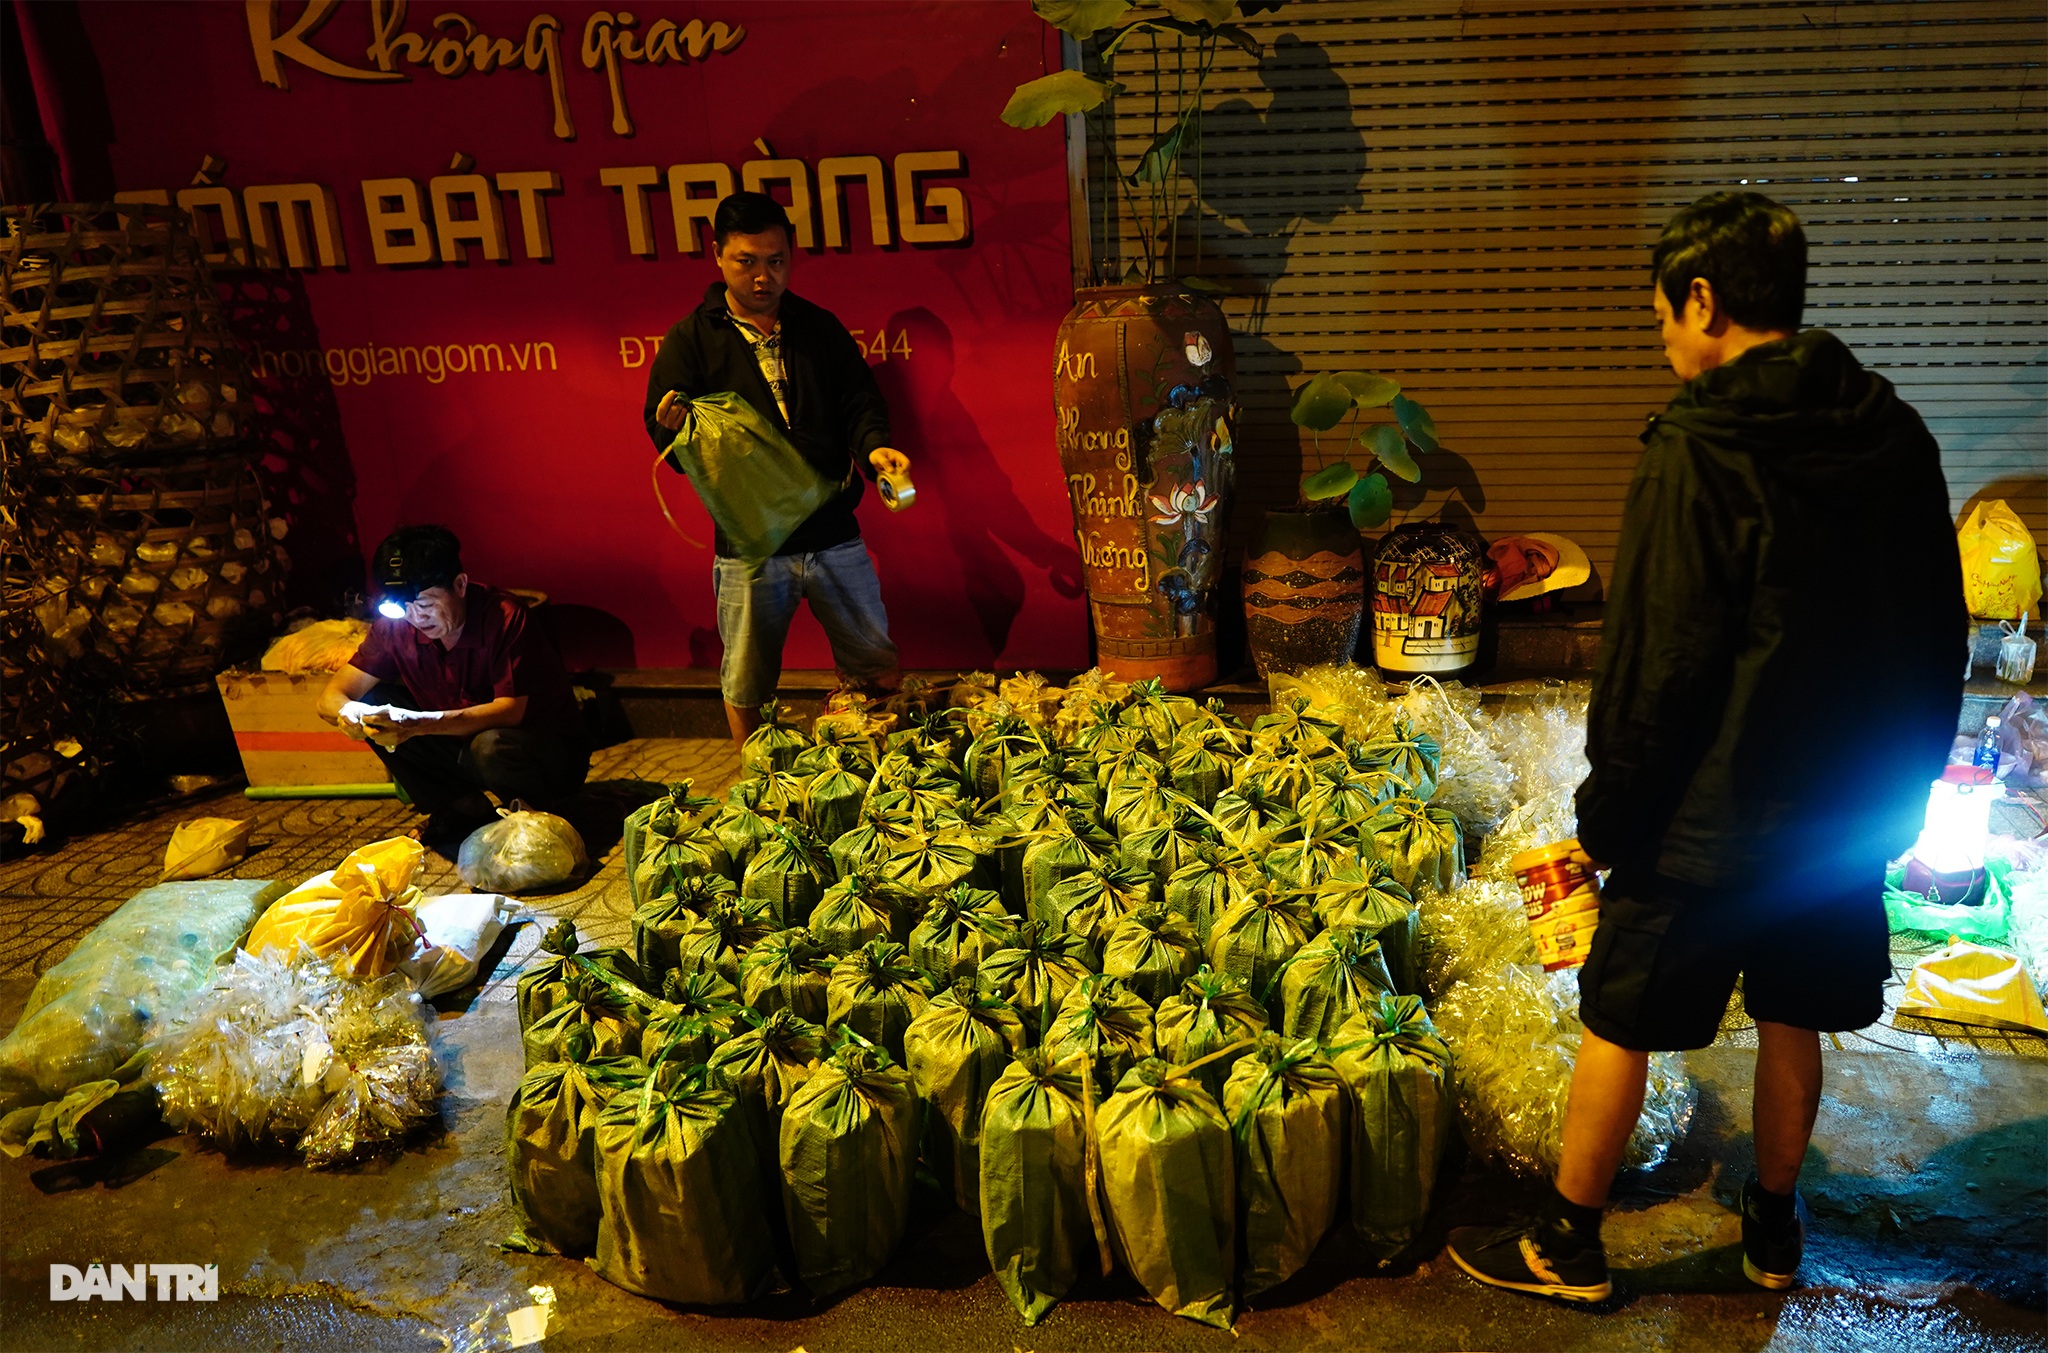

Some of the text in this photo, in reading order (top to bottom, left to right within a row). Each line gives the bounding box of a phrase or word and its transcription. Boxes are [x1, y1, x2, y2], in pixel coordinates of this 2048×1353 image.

[582, 10, 745, 137] gian
[361, 152, 561, 267] BÁT
[600, 137, 970, 255] TRÀNG
[1056, 339, 1098, 383] An
[1060, 406, 1132, 471] Khang
